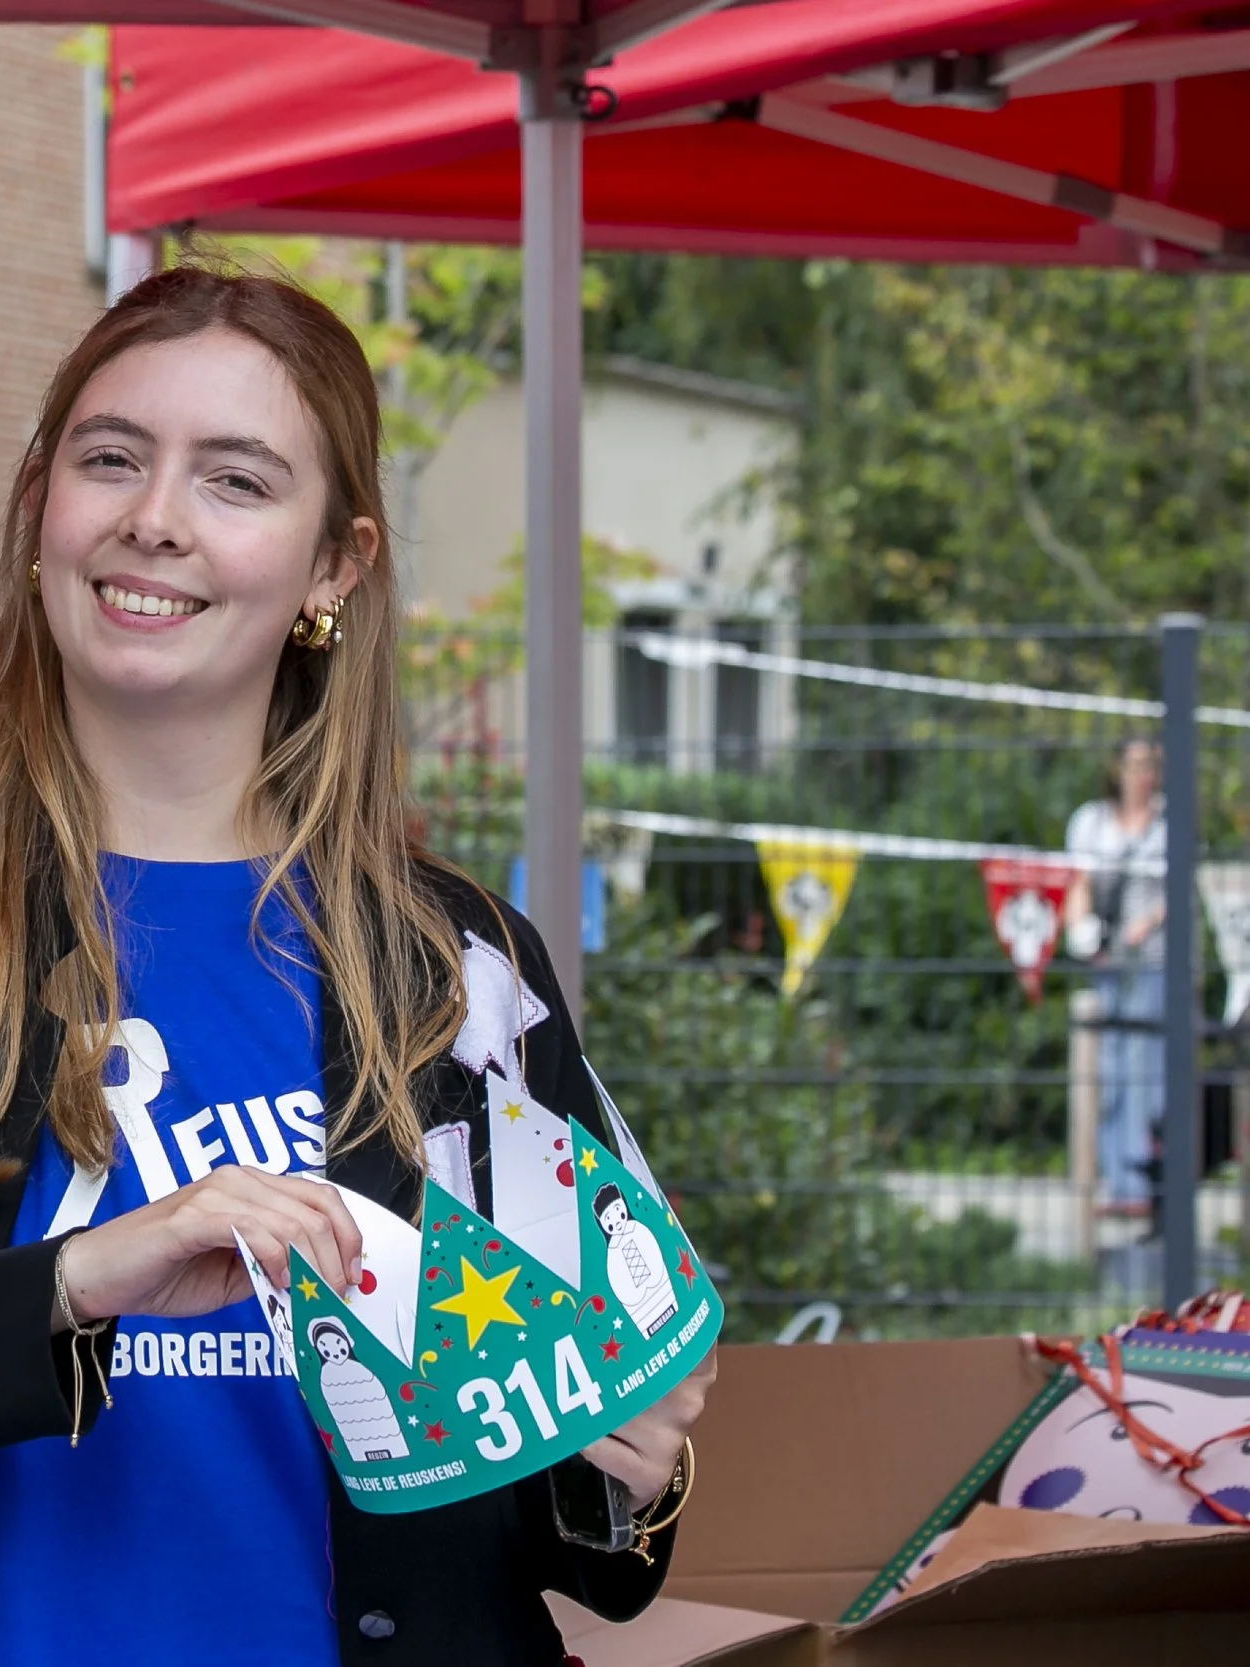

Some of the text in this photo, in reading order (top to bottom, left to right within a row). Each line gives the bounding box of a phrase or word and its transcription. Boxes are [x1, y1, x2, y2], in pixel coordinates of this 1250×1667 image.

[456, 1334, 604, 1461] 314
[615, 1368, 645, 1399] LANG
[644, 1348, 669, 1378] LEVE
[666, 1337, 682, 1358] DE
[359, 1477, 383, 1491] LEVE
[382, 1476, 398, 1491] DE
[398, 1460, 468, 1489] REUSKENS!
